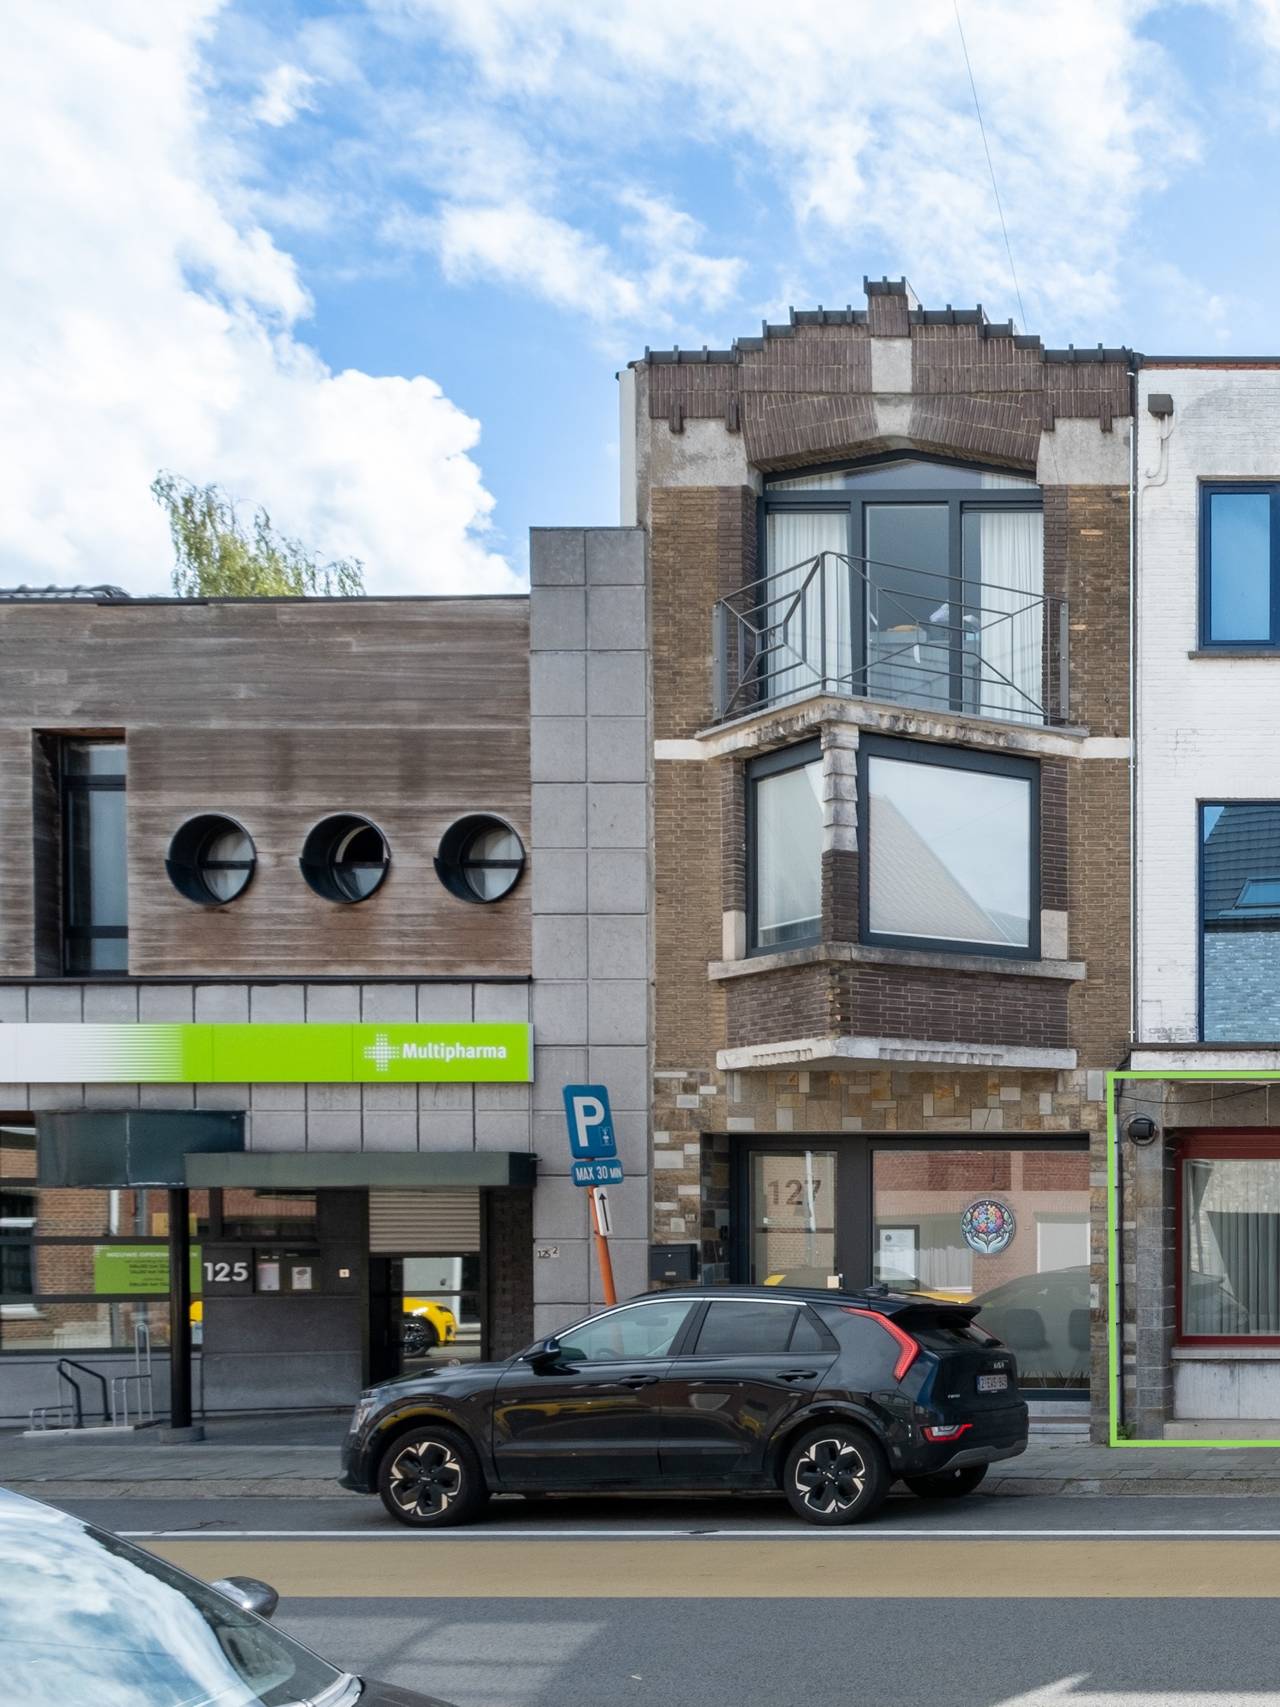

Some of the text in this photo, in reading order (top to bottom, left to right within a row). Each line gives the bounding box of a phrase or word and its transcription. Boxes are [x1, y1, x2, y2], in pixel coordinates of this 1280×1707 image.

[403, 1043, 507, 1062] Multipharma
[573, 1096, 605, 1147] P
[575, 1165, 622, 1181] MAX 30 MIN
[768, 1179, 821, 1205] 127
[204, 1262, 248, 1282] 125
